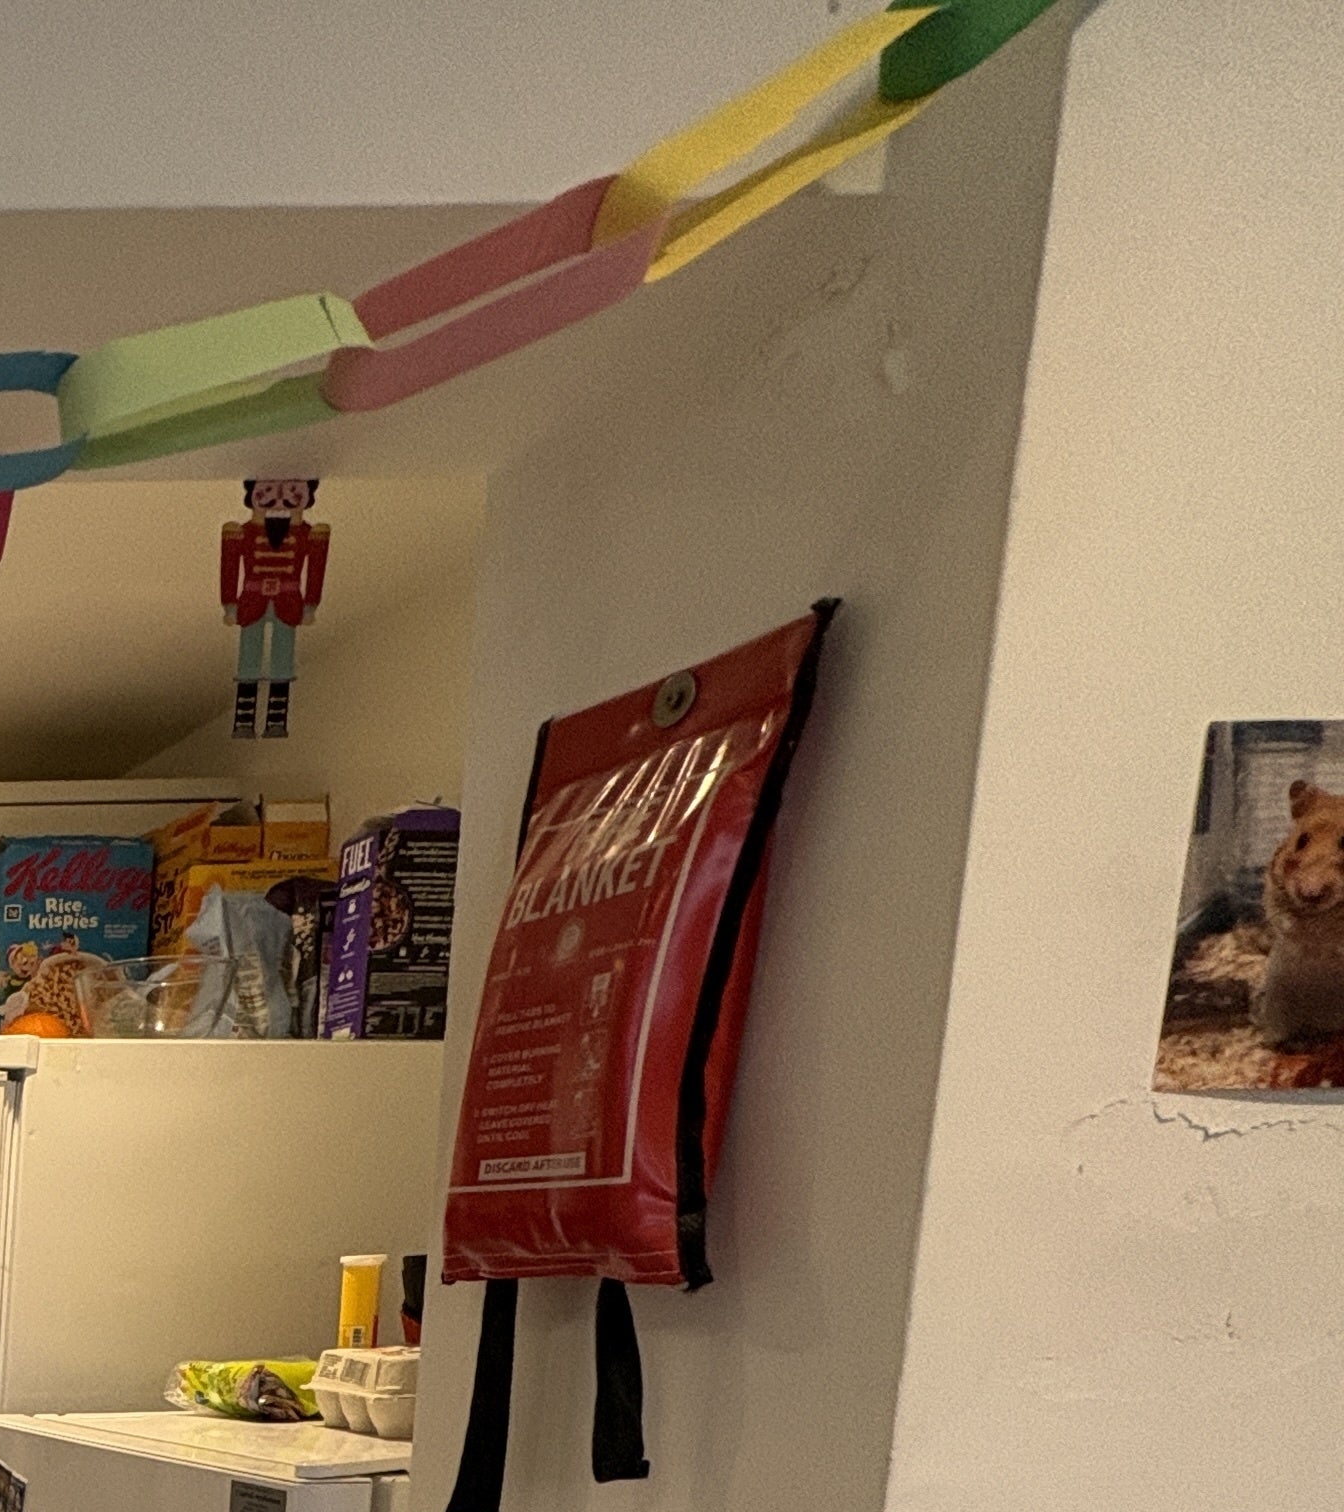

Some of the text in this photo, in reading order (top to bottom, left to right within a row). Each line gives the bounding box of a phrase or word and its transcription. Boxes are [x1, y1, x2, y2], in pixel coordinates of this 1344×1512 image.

[341, 837, 374, 878] FUEL
[505, 834, 679, 930] BLANKET
[45, 897, 83, 914] Rice
[28, 913, 99, 930] Krispies
[484, 1160, 530, 1175] DISCARD
